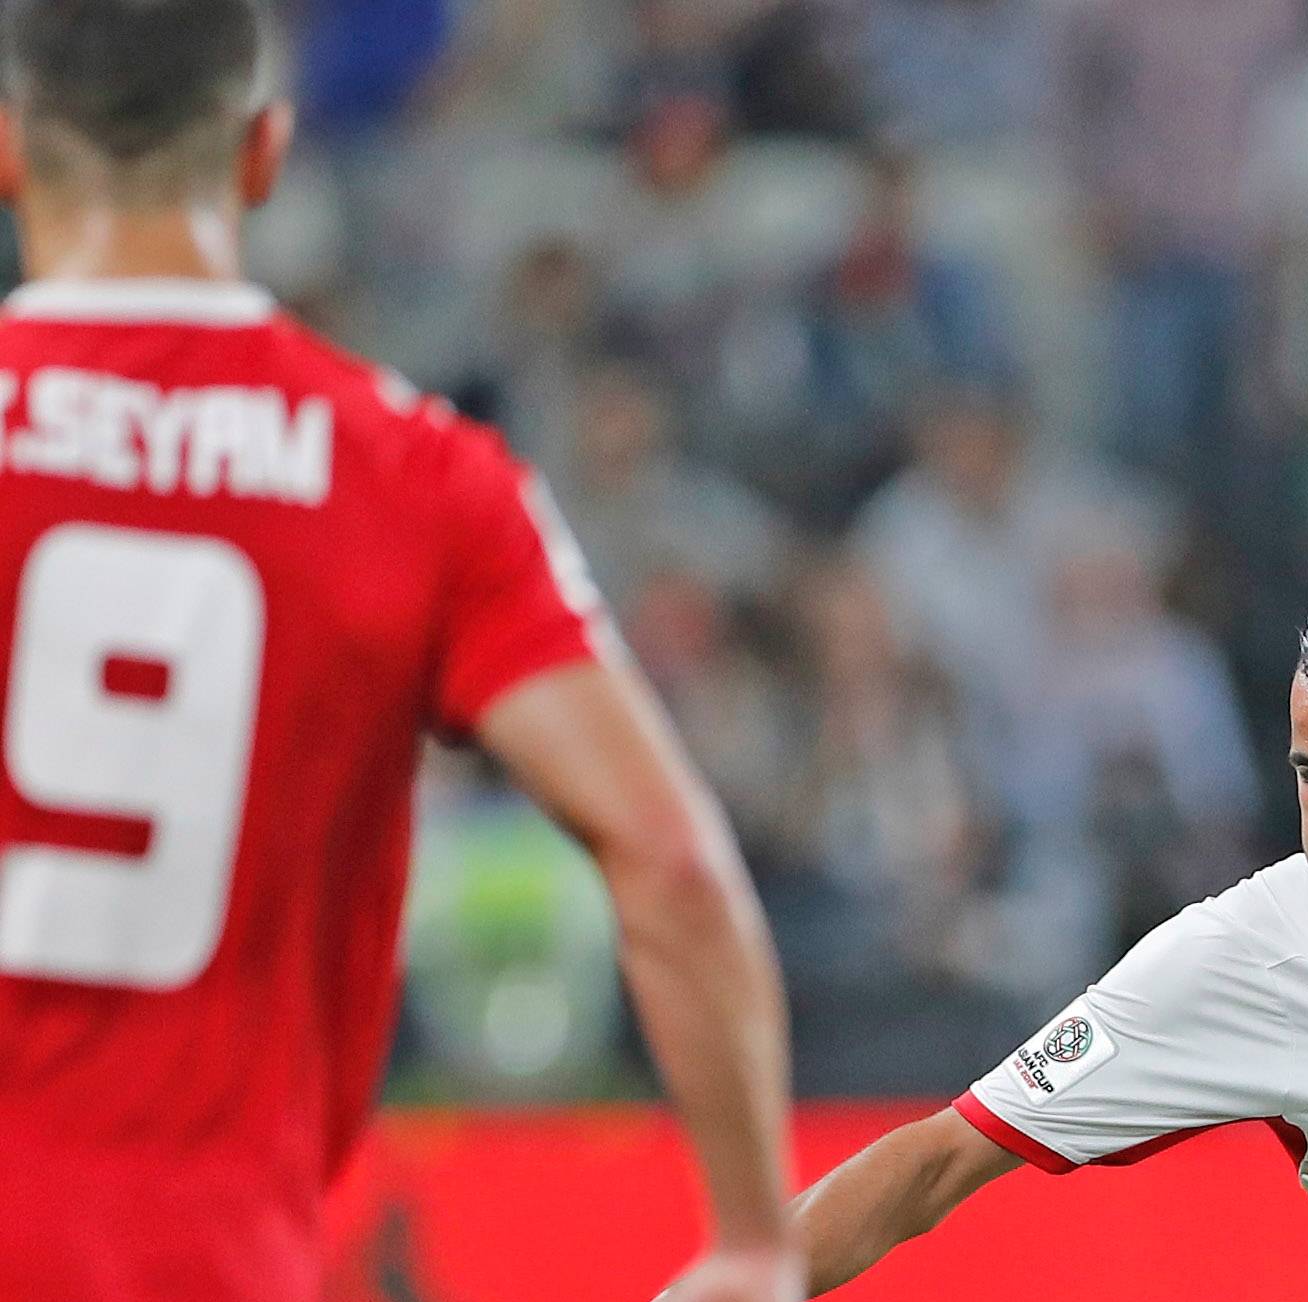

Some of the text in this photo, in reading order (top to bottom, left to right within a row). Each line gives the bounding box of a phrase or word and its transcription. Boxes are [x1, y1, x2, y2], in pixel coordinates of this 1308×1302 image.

[0, 520, 266, 993] 9
[1032, 1050, 1049, 1068] AFC
[1032, 1069, 1055, 1093] CUP
